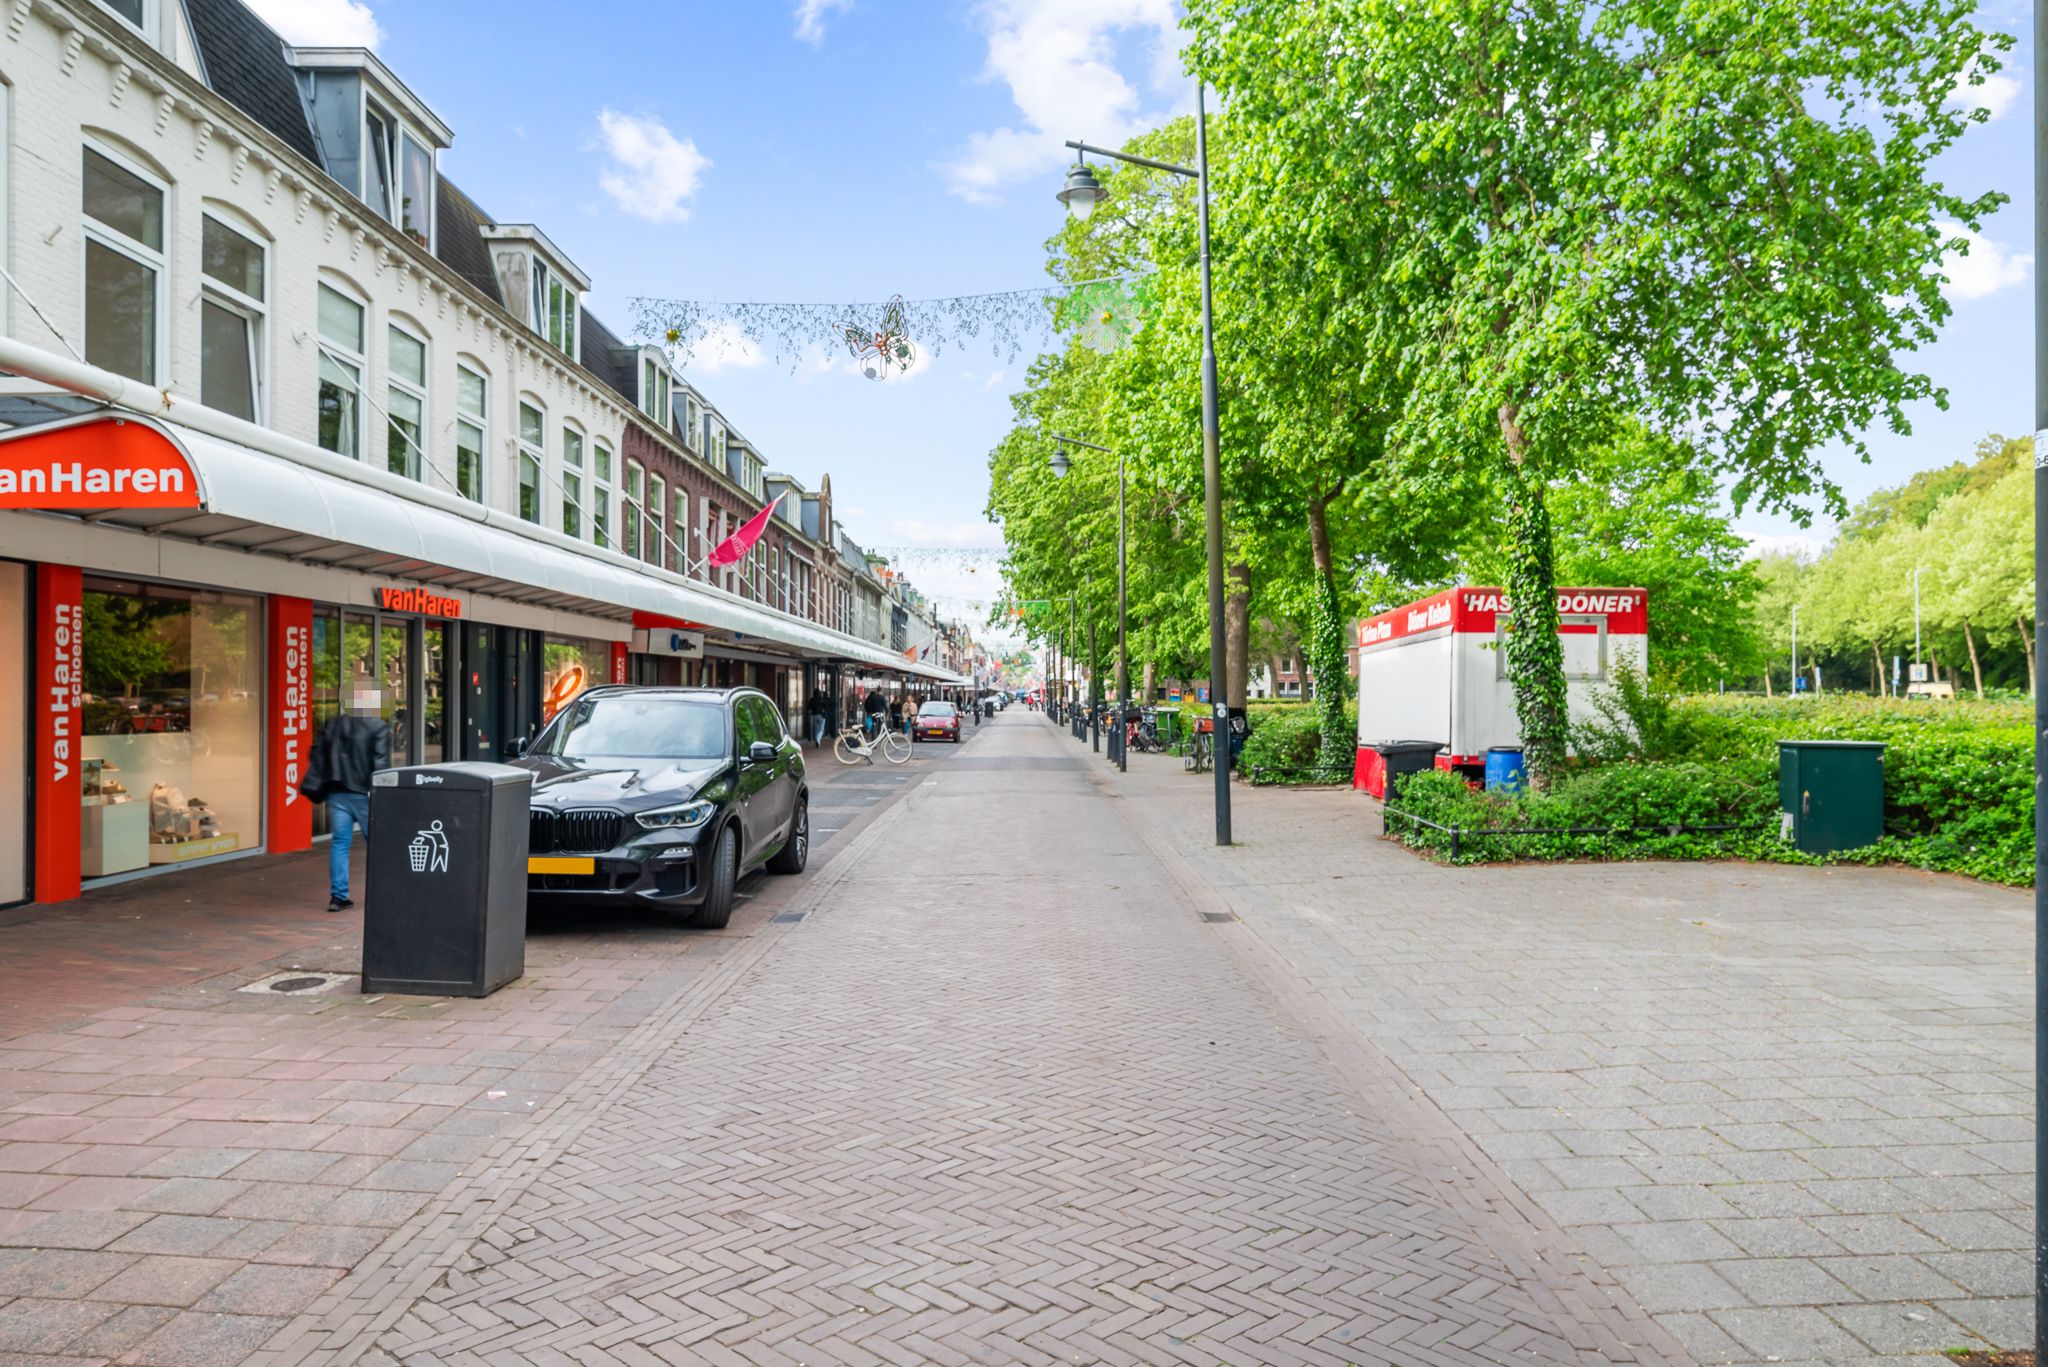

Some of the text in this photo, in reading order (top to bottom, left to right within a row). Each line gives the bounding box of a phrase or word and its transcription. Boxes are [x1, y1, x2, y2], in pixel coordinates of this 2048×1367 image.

[0, 462, 183, 493] anHaren
[382, 586, 462, 618] vanHaren
[1407, 609, 1428, 633] Döner
[1428, 599, 1452, 627] Kebab
[1556, 592, 1633, 613] DÖNER
[70, 605, 82, 708] schoenen
[298, 627, 307, 731] schoenen
[51, 603, 70, 782] vanHaren
[283, 626, 298, 806] vanHaren
